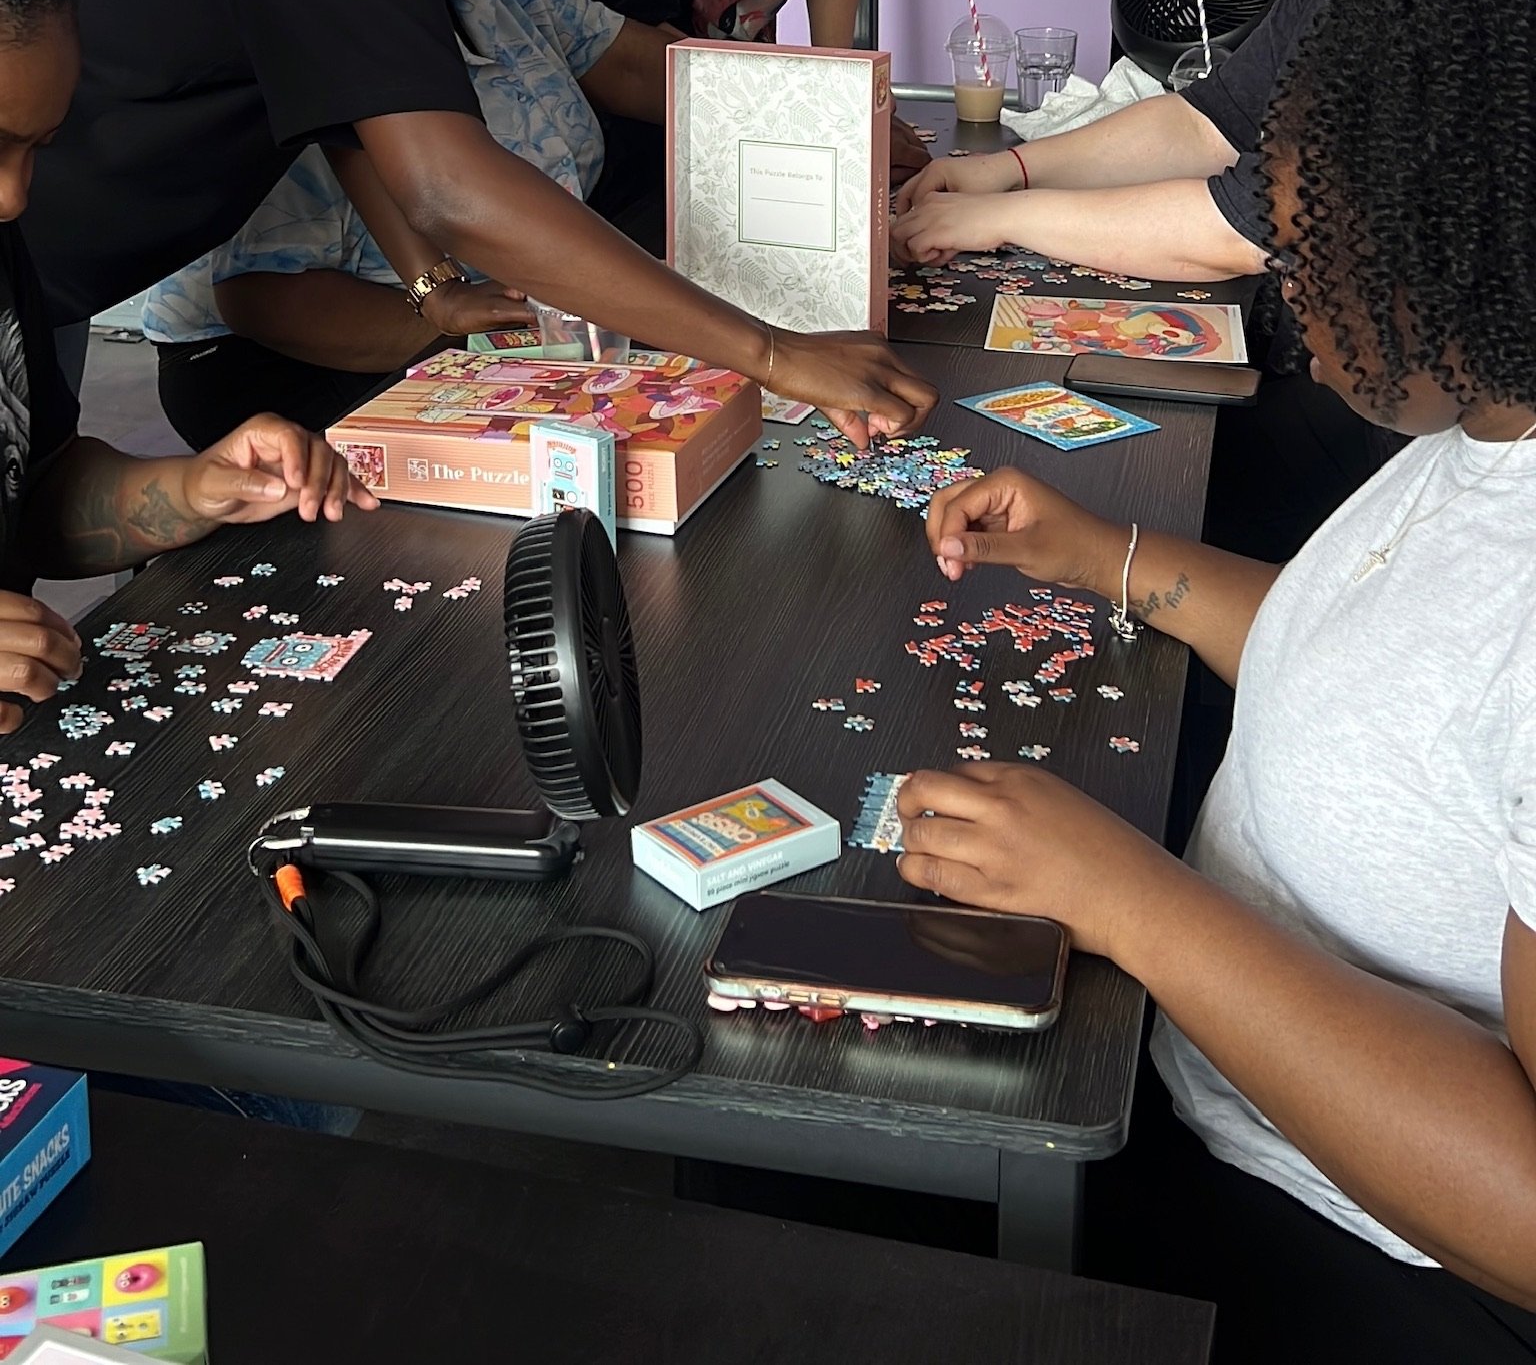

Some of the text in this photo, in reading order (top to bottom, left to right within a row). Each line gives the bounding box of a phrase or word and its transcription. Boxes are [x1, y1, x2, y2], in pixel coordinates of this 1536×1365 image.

[431, 463, 465, 481] The
[470, 466, 530, 485] Puzzle
[625, 460, 645, 510] 500
[706, 851, 784, 886] SALT AND VINEGAR
[23, 1123, 70, 1190] SNACKS
